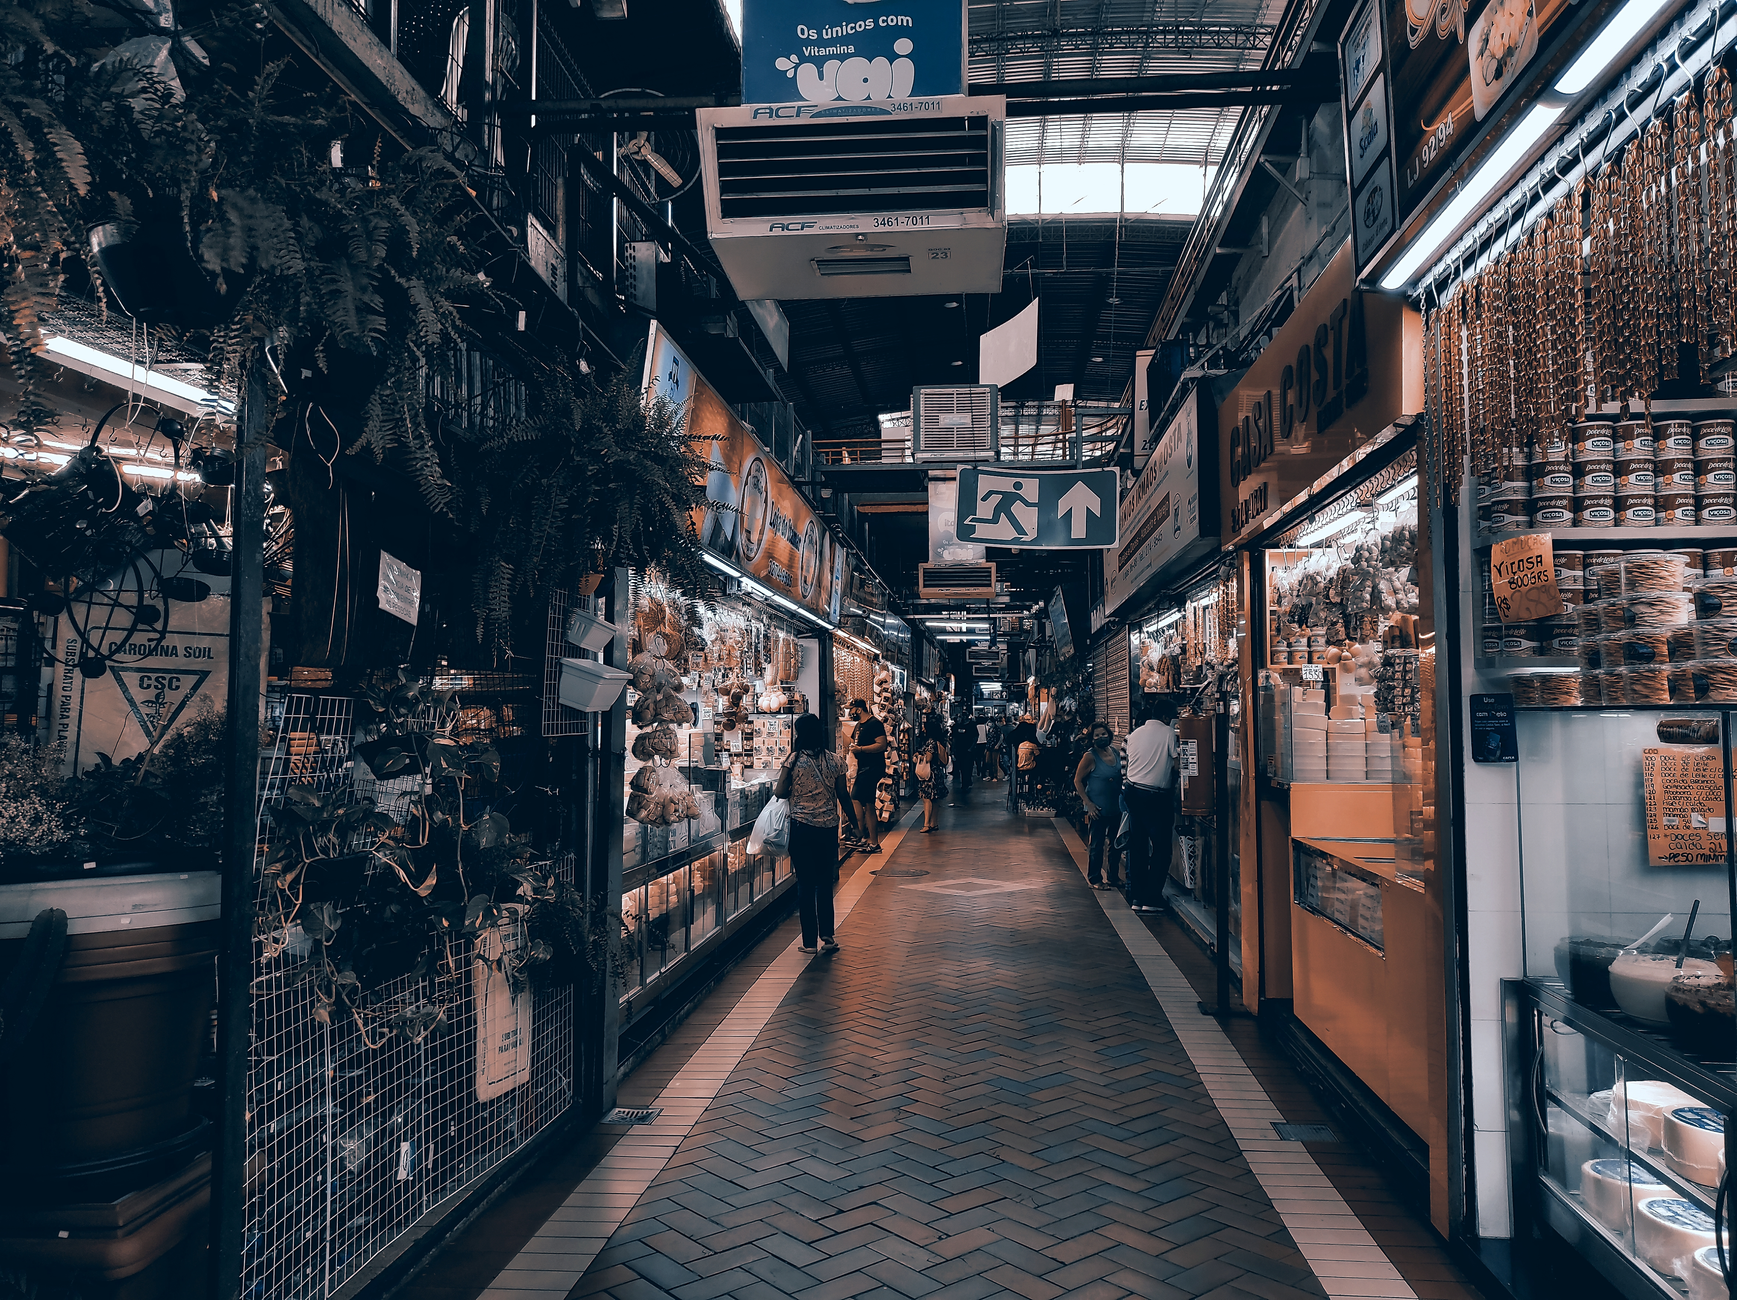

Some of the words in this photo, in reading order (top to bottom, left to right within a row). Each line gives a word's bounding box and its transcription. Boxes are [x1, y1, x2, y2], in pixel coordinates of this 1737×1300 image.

[797, 24, 818, 40] Os
[822, 18, 874, 39] únicos
[878, 15, 913, 28] com
[802, 44, 855, 56] Vitamina
[796, 38, 915, 101] uai
[753, 104, 818, 119] ACF
[890, 101, 941, 112] 3461-7011
[1358, 121, 1378, 159] Scala
[1405, 158, 1422, 189] LJ
[1421, 112, 1454, 169] 92/94
[769, 222, 818, 232] ACF
[873, 216, 931, 228] 3461-7011
[930, 252, 949, 260] 23
[1230, 390, 1273, 488] CASA
[1279, 292, 1368, 439] COSTA
[1508, 570, 1549, 590] 800GRS
[1496, 595, 1511, 618] R$
[108, 642, 178, 658] CAROLINA
[184, 646, 214, 660] SOIL
[138, 674, 182, 691] CSC
[58, 694, 72, 720] PARA
